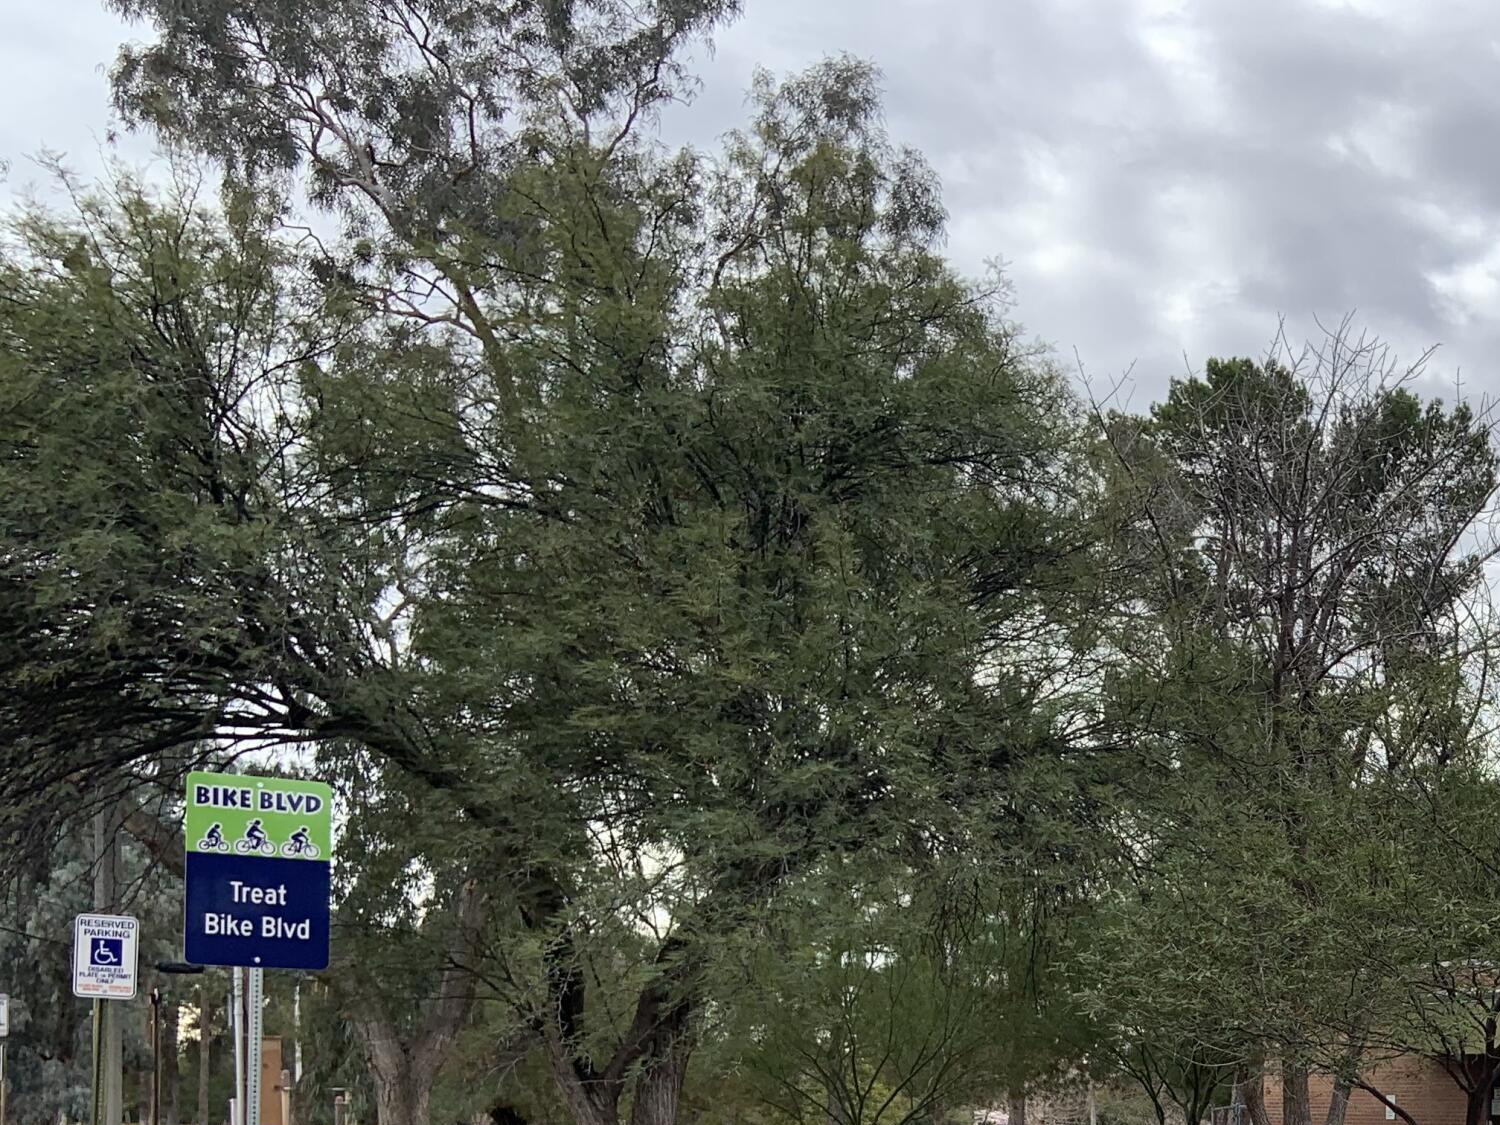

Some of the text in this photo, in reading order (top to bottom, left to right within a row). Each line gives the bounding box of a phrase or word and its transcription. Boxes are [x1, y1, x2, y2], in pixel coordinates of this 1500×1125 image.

[195, 785, 322, 814] BIKE BLVD
[230, 880, 287, 905] Treat
[80, 919, 135, 929] RESERVED
[83, 928, 130, 938] PARKING
[204, 912, 310, 940] Bike Blvd
